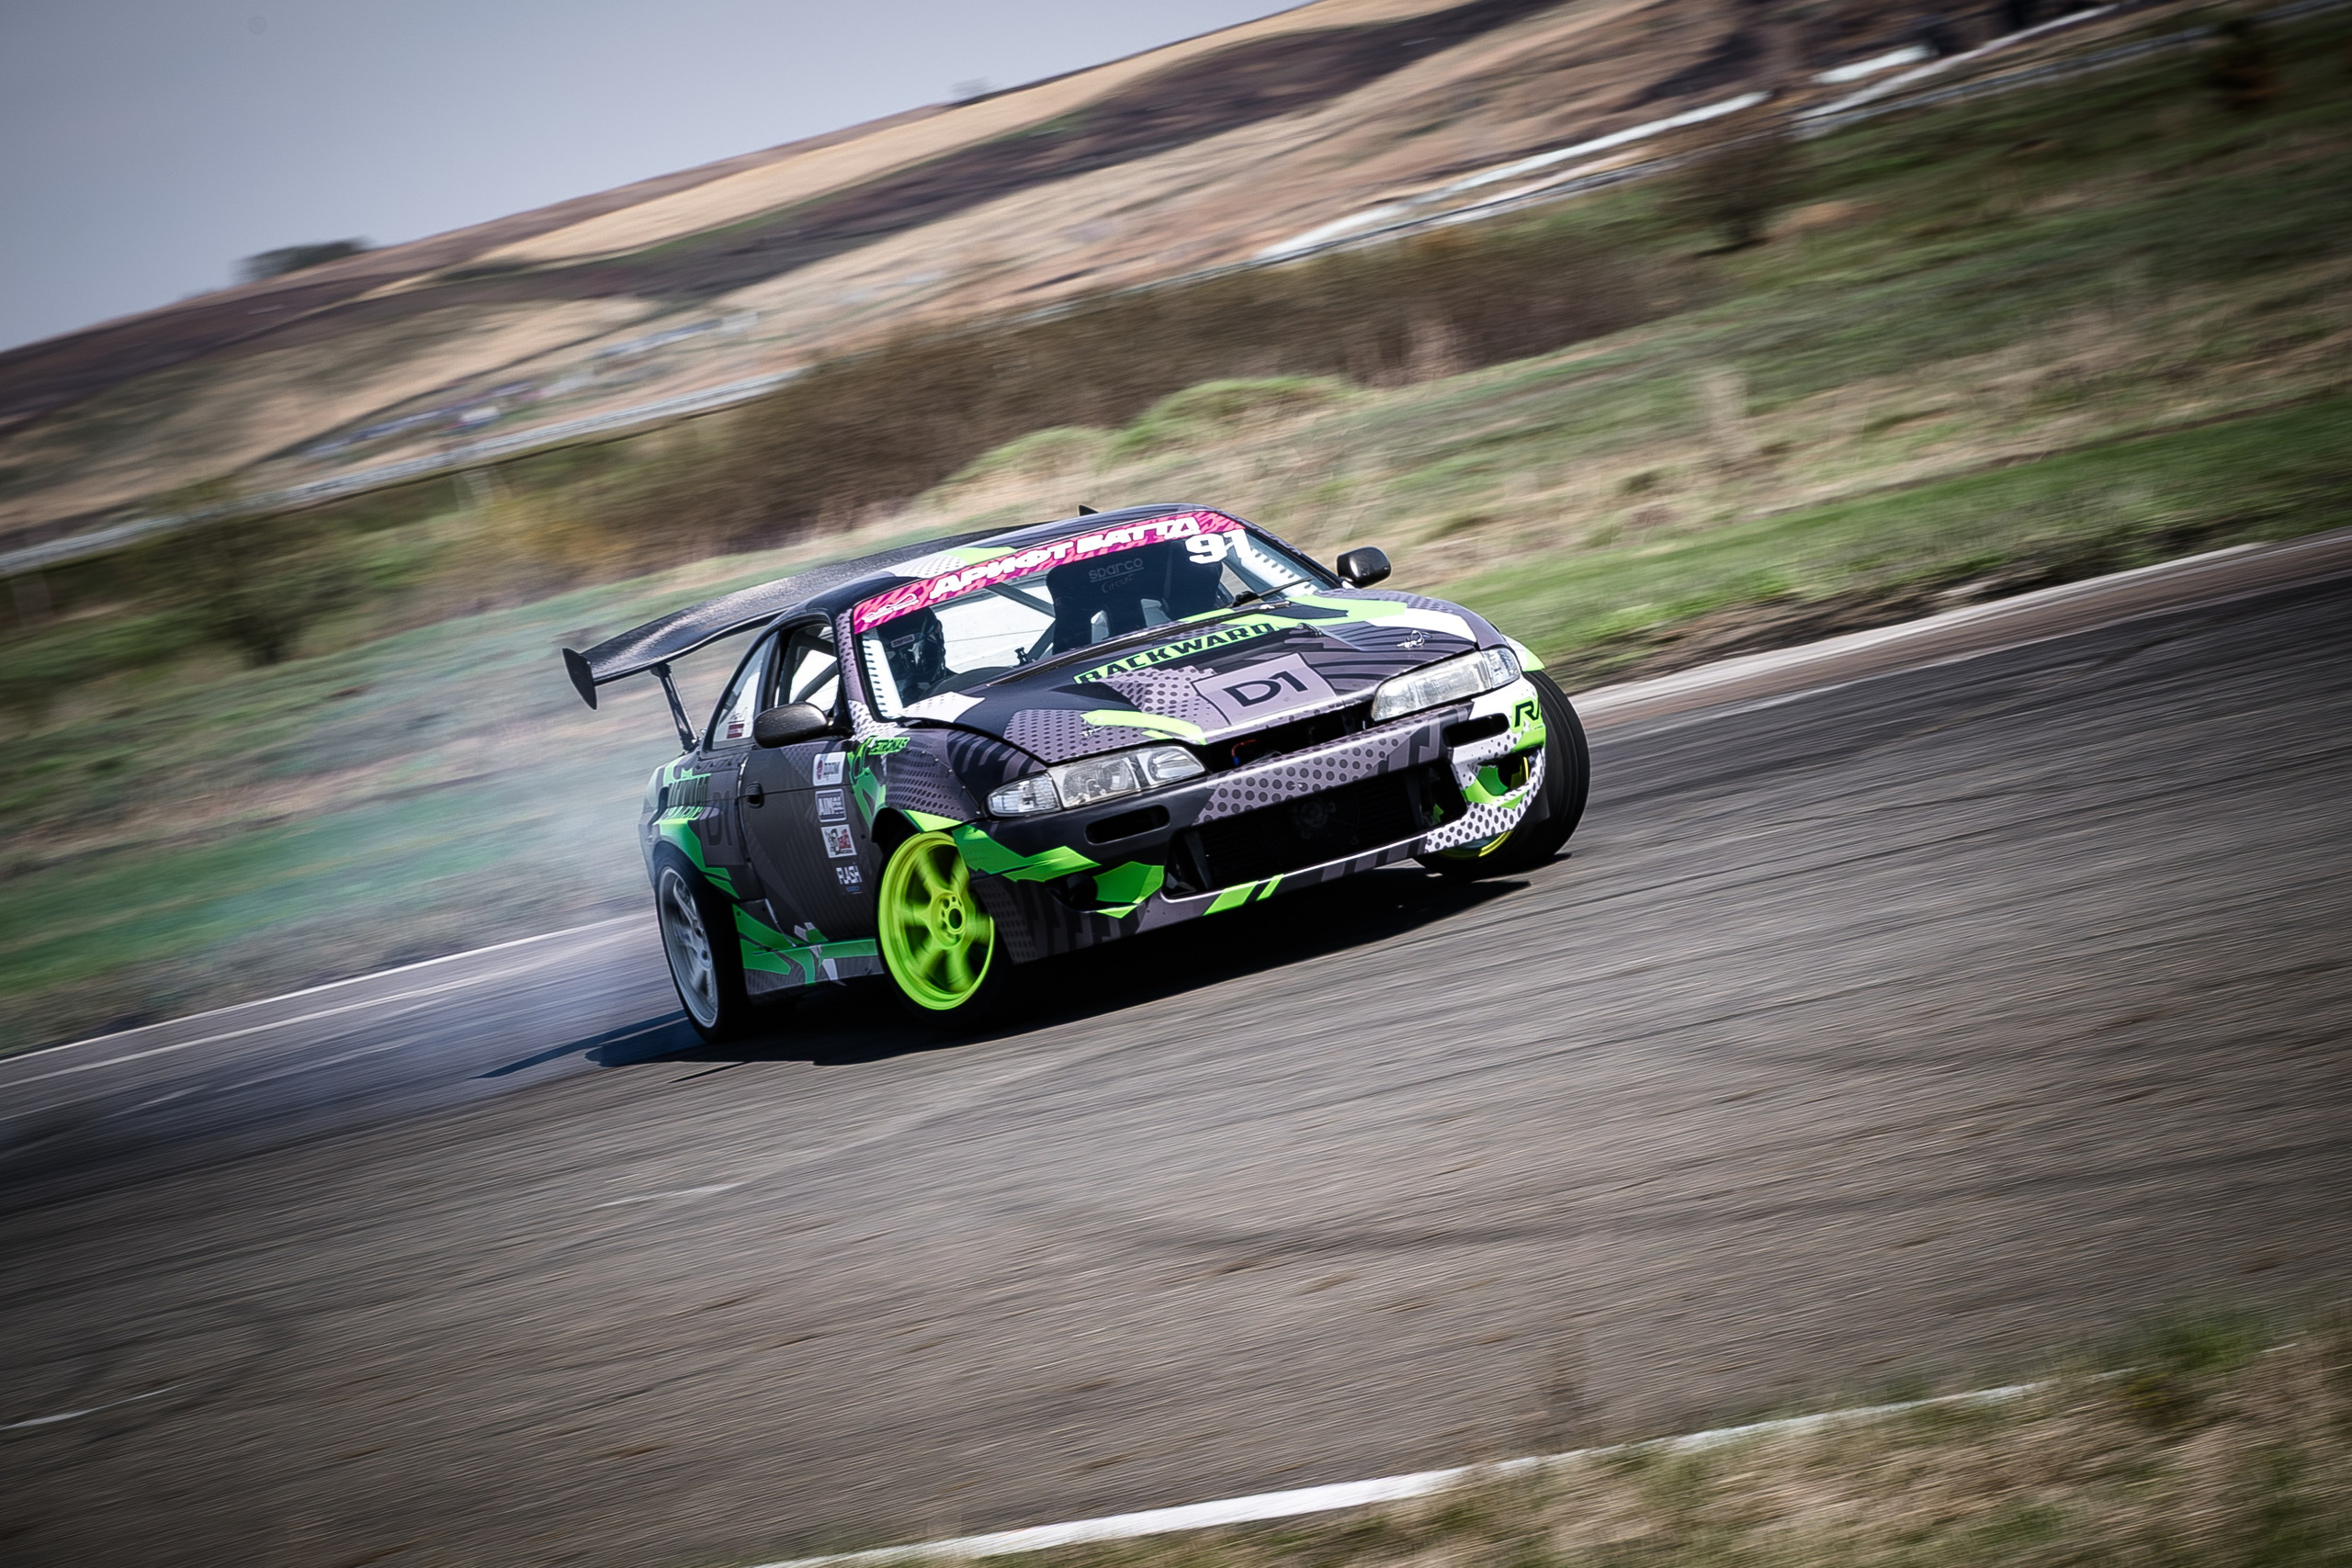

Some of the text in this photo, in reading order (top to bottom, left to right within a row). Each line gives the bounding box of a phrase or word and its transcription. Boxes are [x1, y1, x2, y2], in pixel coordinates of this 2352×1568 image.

[1185, 528, 1251, 565] 91
[1088, 558, 1144, 581] sparco
[1076, 623, 1275, 684] BACKWARD
[1221, 670, 1309, 708] D1
[1514, 700, 1540, 728] R
